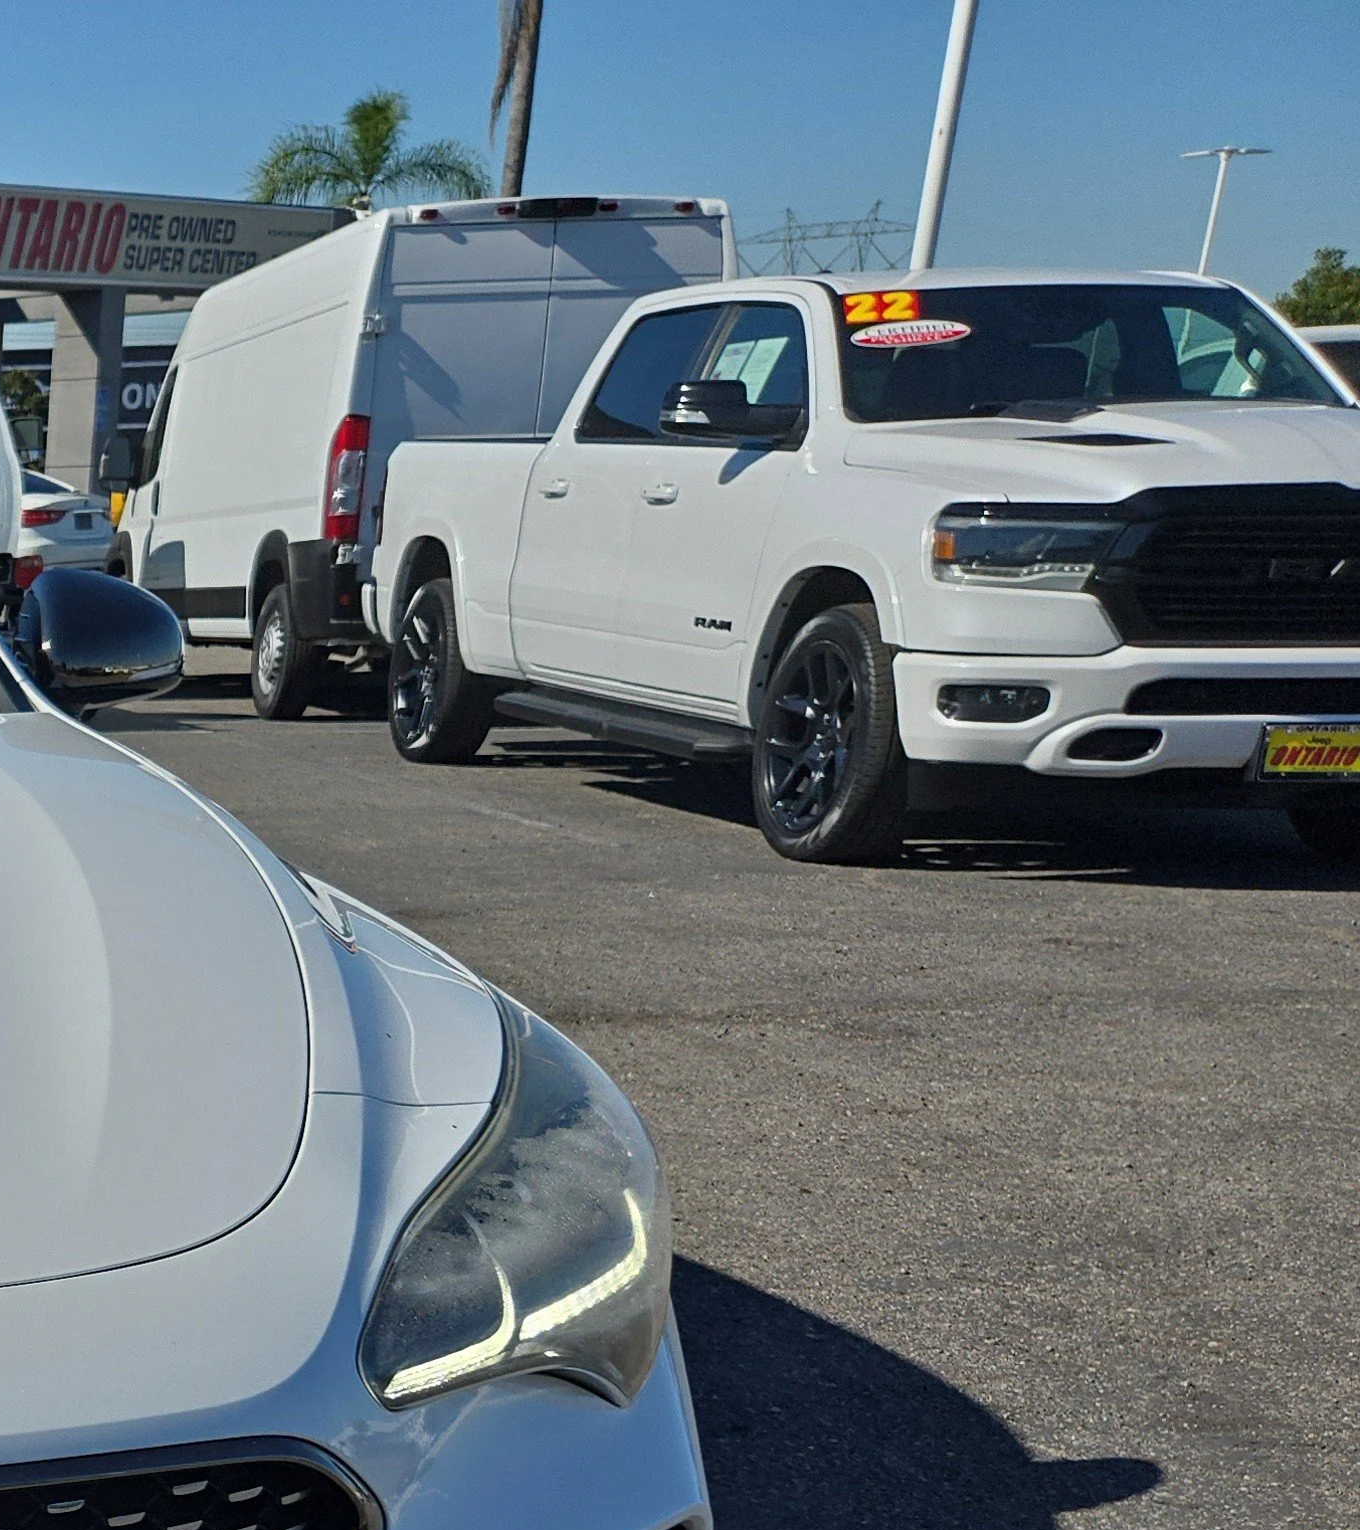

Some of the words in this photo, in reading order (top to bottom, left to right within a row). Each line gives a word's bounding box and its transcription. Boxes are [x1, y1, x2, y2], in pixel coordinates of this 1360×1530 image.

[125, 212, 164, 240] PRE
[167, 216, 237, 244] OWNED
[123, 244, 184, 271] SUPER
[188, 248, 257, 275] CENTER
[845, 291, 915, 325] 22
[693, 617, 732, 632] RAM
[1270, 746, 1360, 766] ONTARIO
